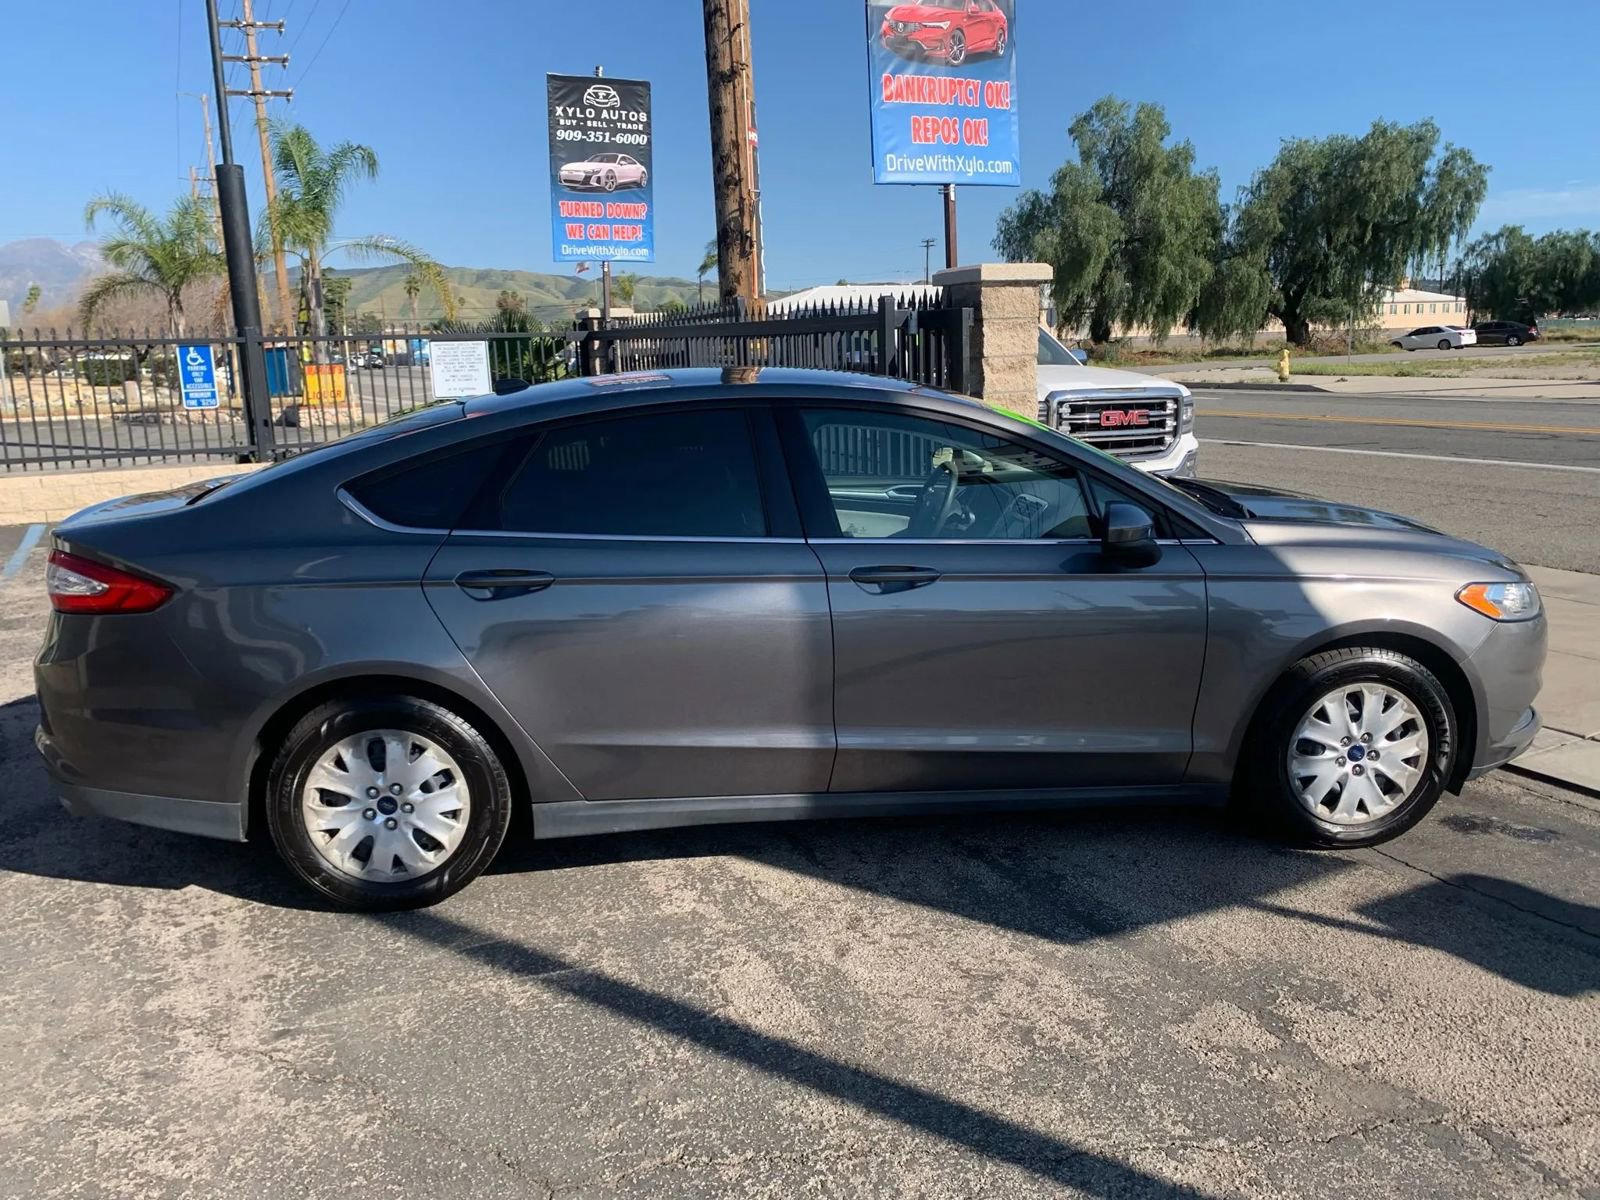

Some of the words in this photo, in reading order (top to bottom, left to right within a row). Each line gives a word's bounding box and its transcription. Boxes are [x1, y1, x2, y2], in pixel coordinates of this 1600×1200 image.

[882, 73, 981, 107] BANKRUPTCY
[984, 81, 1011, 110] OK!
[555, 106, 596, 119] XYLO
[601, 108, 648, 122] AUTOS
[559, 119, 577, 127] BUY
[616, 122, 644, 131] TRADE
[911, 116, 960, 145] REPOS
[963, 118, 989, 147] OK!
[556, 129, 648, 146] 909-351-6000
[886, 153, 1013, 176] DriveWithXylo.com
[559, 201, 604, 218] TURNED
[606, 202, 648, 220] DOWN?
[565, 223, 584, 240] WE
[587, 224, 611, 240] CAN
[613, 224, 643, 241] HELP!
[561, 244, 649, 257] DriveWithXylo.com
[1101, 409, 1150, 427] GMC
